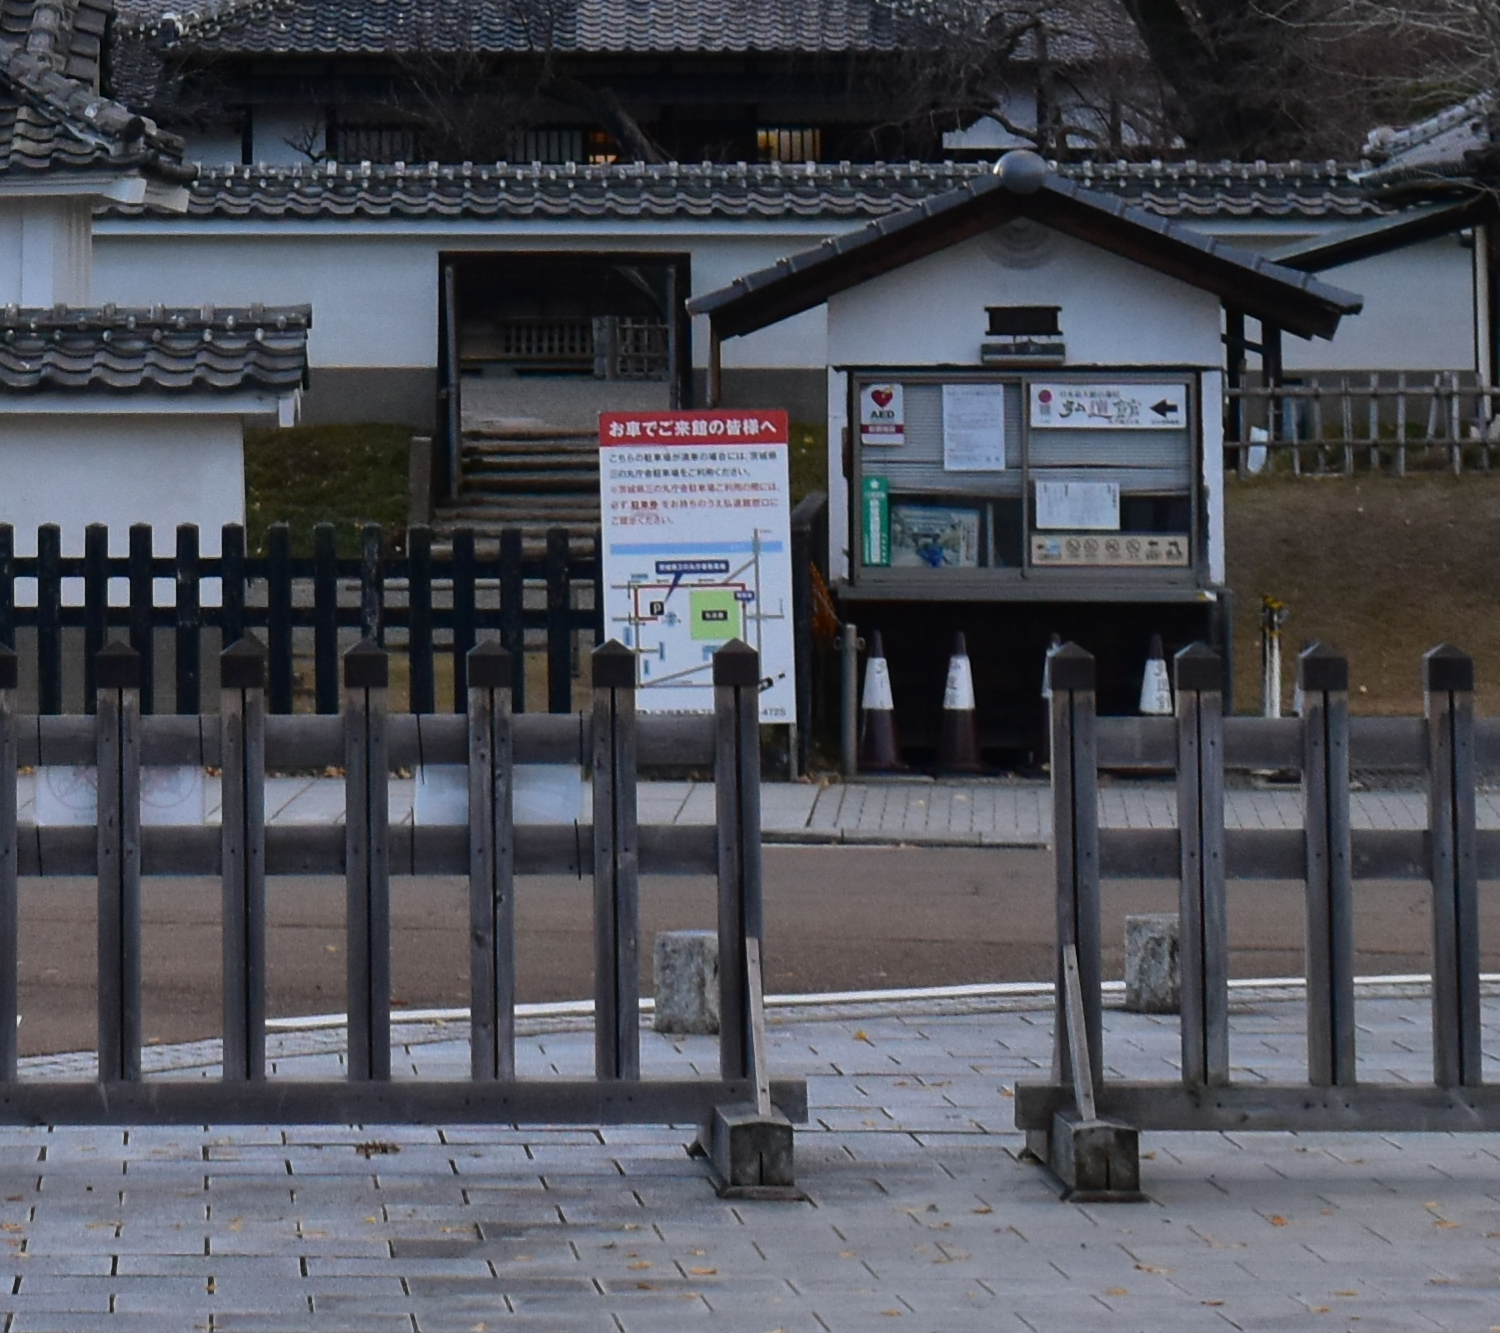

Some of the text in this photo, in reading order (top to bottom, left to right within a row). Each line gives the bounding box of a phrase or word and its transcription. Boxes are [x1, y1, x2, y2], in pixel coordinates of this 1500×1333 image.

[870, 410, 895, 420] AED
[609, 419, 777, 438] お車でご来館の皆様へ
